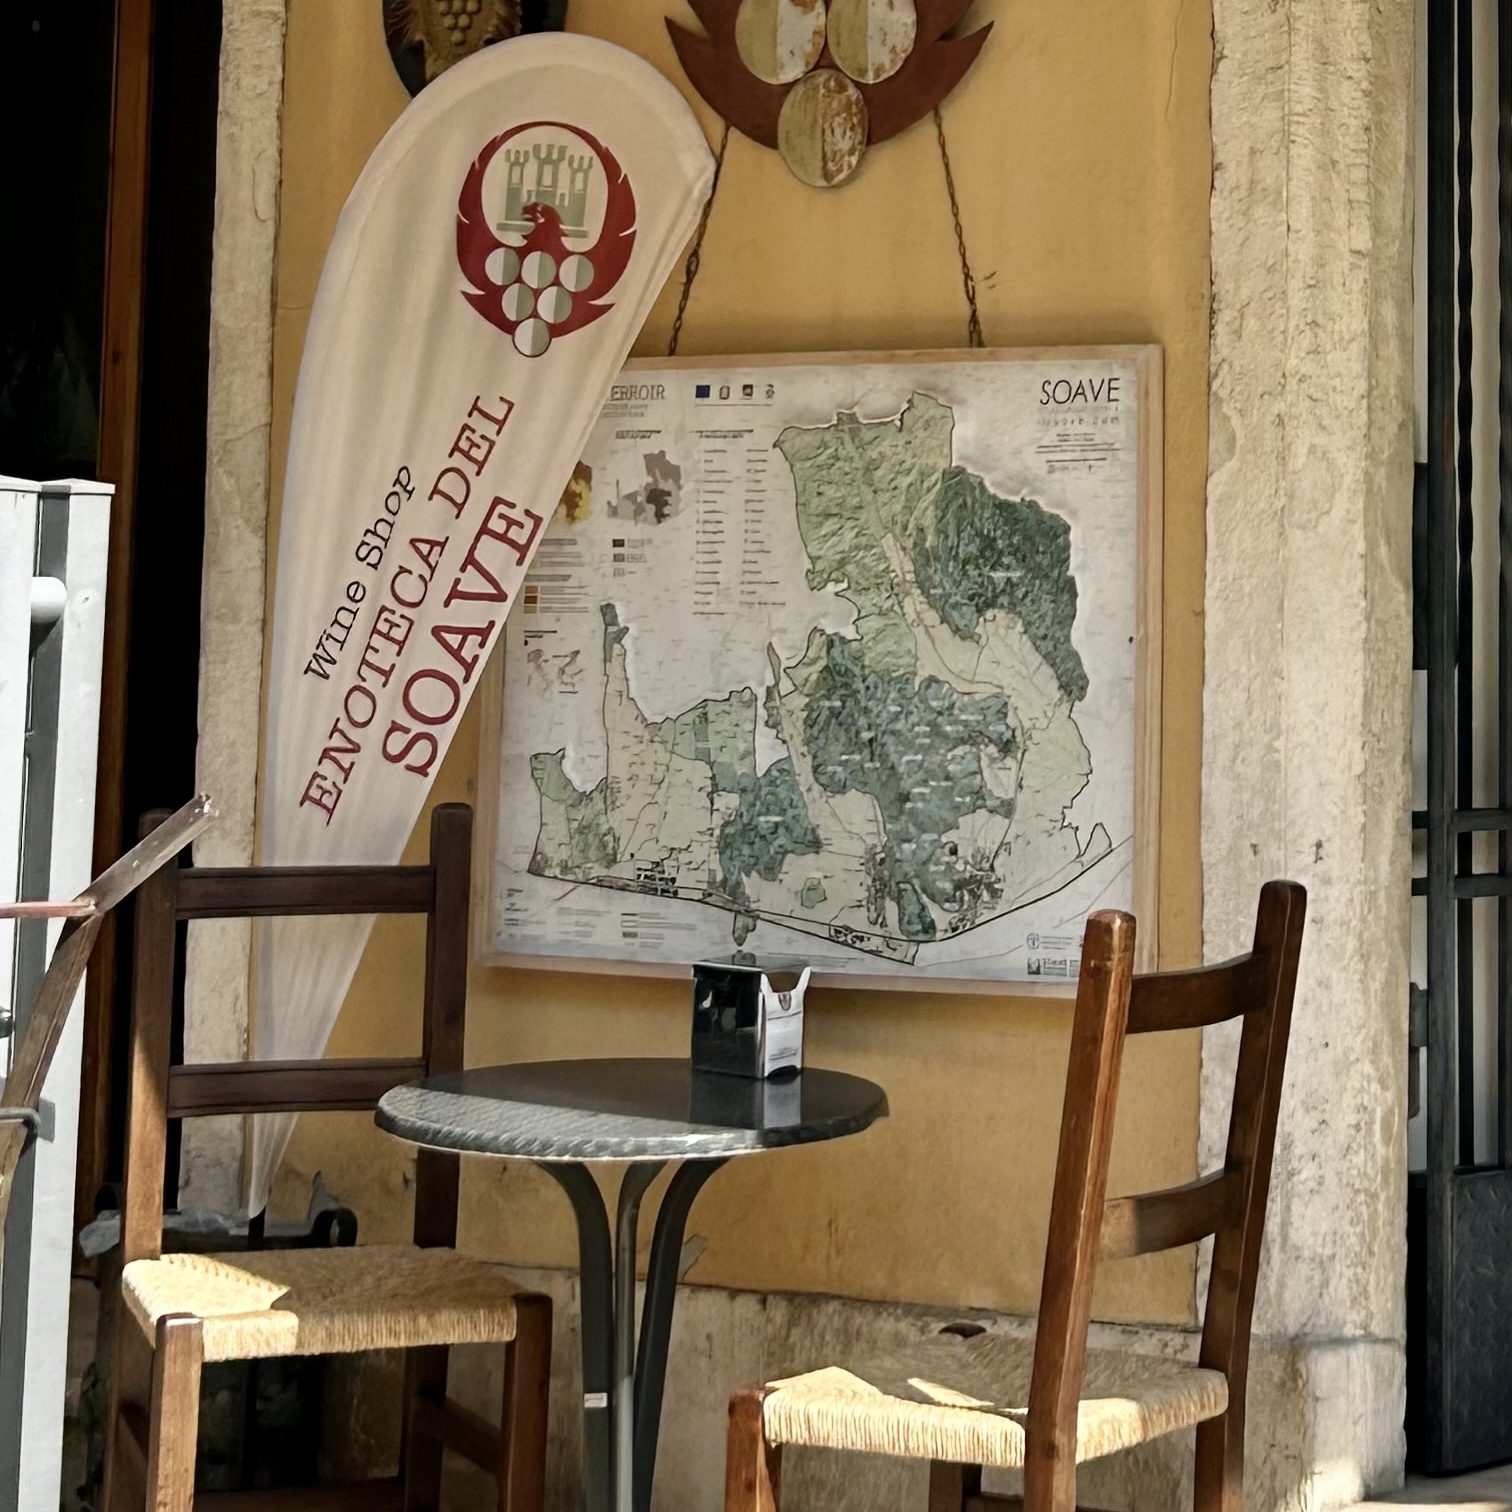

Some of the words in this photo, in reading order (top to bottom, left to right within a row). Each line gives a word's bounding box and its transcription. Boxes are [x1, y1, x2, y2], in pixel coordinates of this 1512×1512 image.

[1040, 377, 1120, 405] SOAVE
[299, 535, 450, 827] ENOTECA
[427, 395, 516, 520] DEL
[303, 581, 367, 681] Wine
[355, 465, 415, 571] Shop
[382, 495, 544, 778] SOAVE
